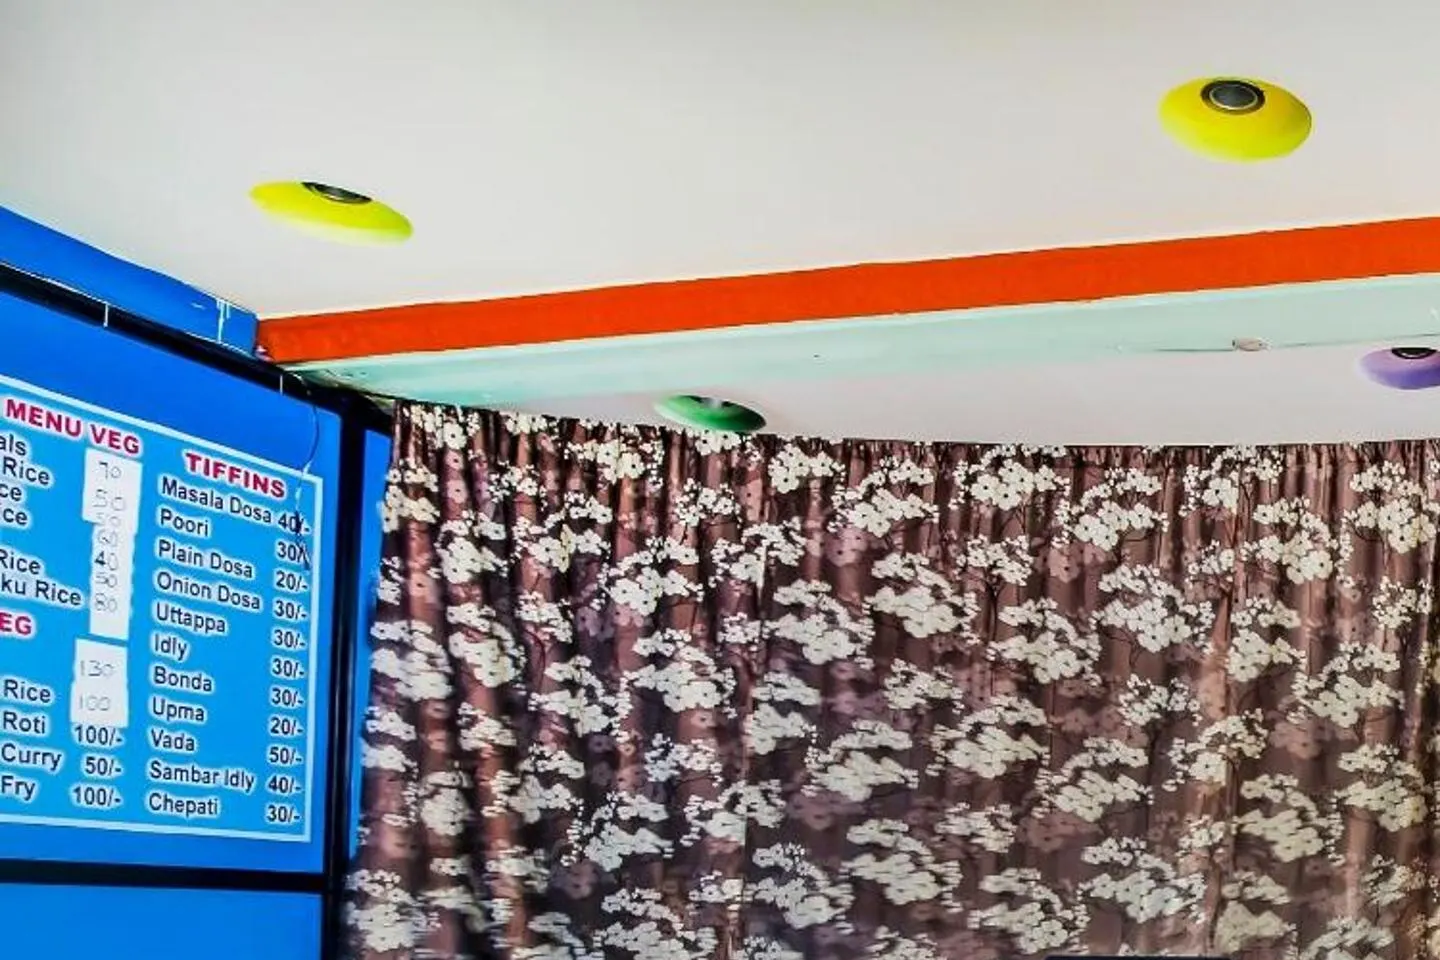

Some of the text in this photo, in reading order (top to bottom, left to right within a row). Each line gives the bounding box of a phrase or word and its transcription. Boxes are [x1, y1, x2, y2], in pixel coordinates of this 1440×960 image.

[6, 399, 139, 454] MENU VEG
[3, 456, 50, 485] Rice
[185, 453, 285, 498] TIFFINS
[162, 476, 223, 510] Masala
[230, 496, 271, 524] Dosa
[160, 508, 208, 536] Poori
[159, 540, 308, 592] Plain Dosa 20/-
[35, 580, 81, 605] Rice
[157, 572, 307, 620] Onion Dosa 30/-
[156, 602, 305, 648] Uttappa 30/-
[154, 634, 304, 678] Idly 30/-
[4, 679, 51, 703] Rice
[154, 666, 303, 707] Bonda 30/-
[3, 711, 123, 746] Roti 100/-
[152, 697, 303, 735] Upma 20/-
[1, 743, 122, 776] Curry 50/-
[151, 729, 302, 764] Vada 50/-
[1, 775, 122, 808] Fry 100/-
[150, 760, 301, 794] Sambar Idly 40/-
[149, 793, 299, 823] Chepati 30/-
